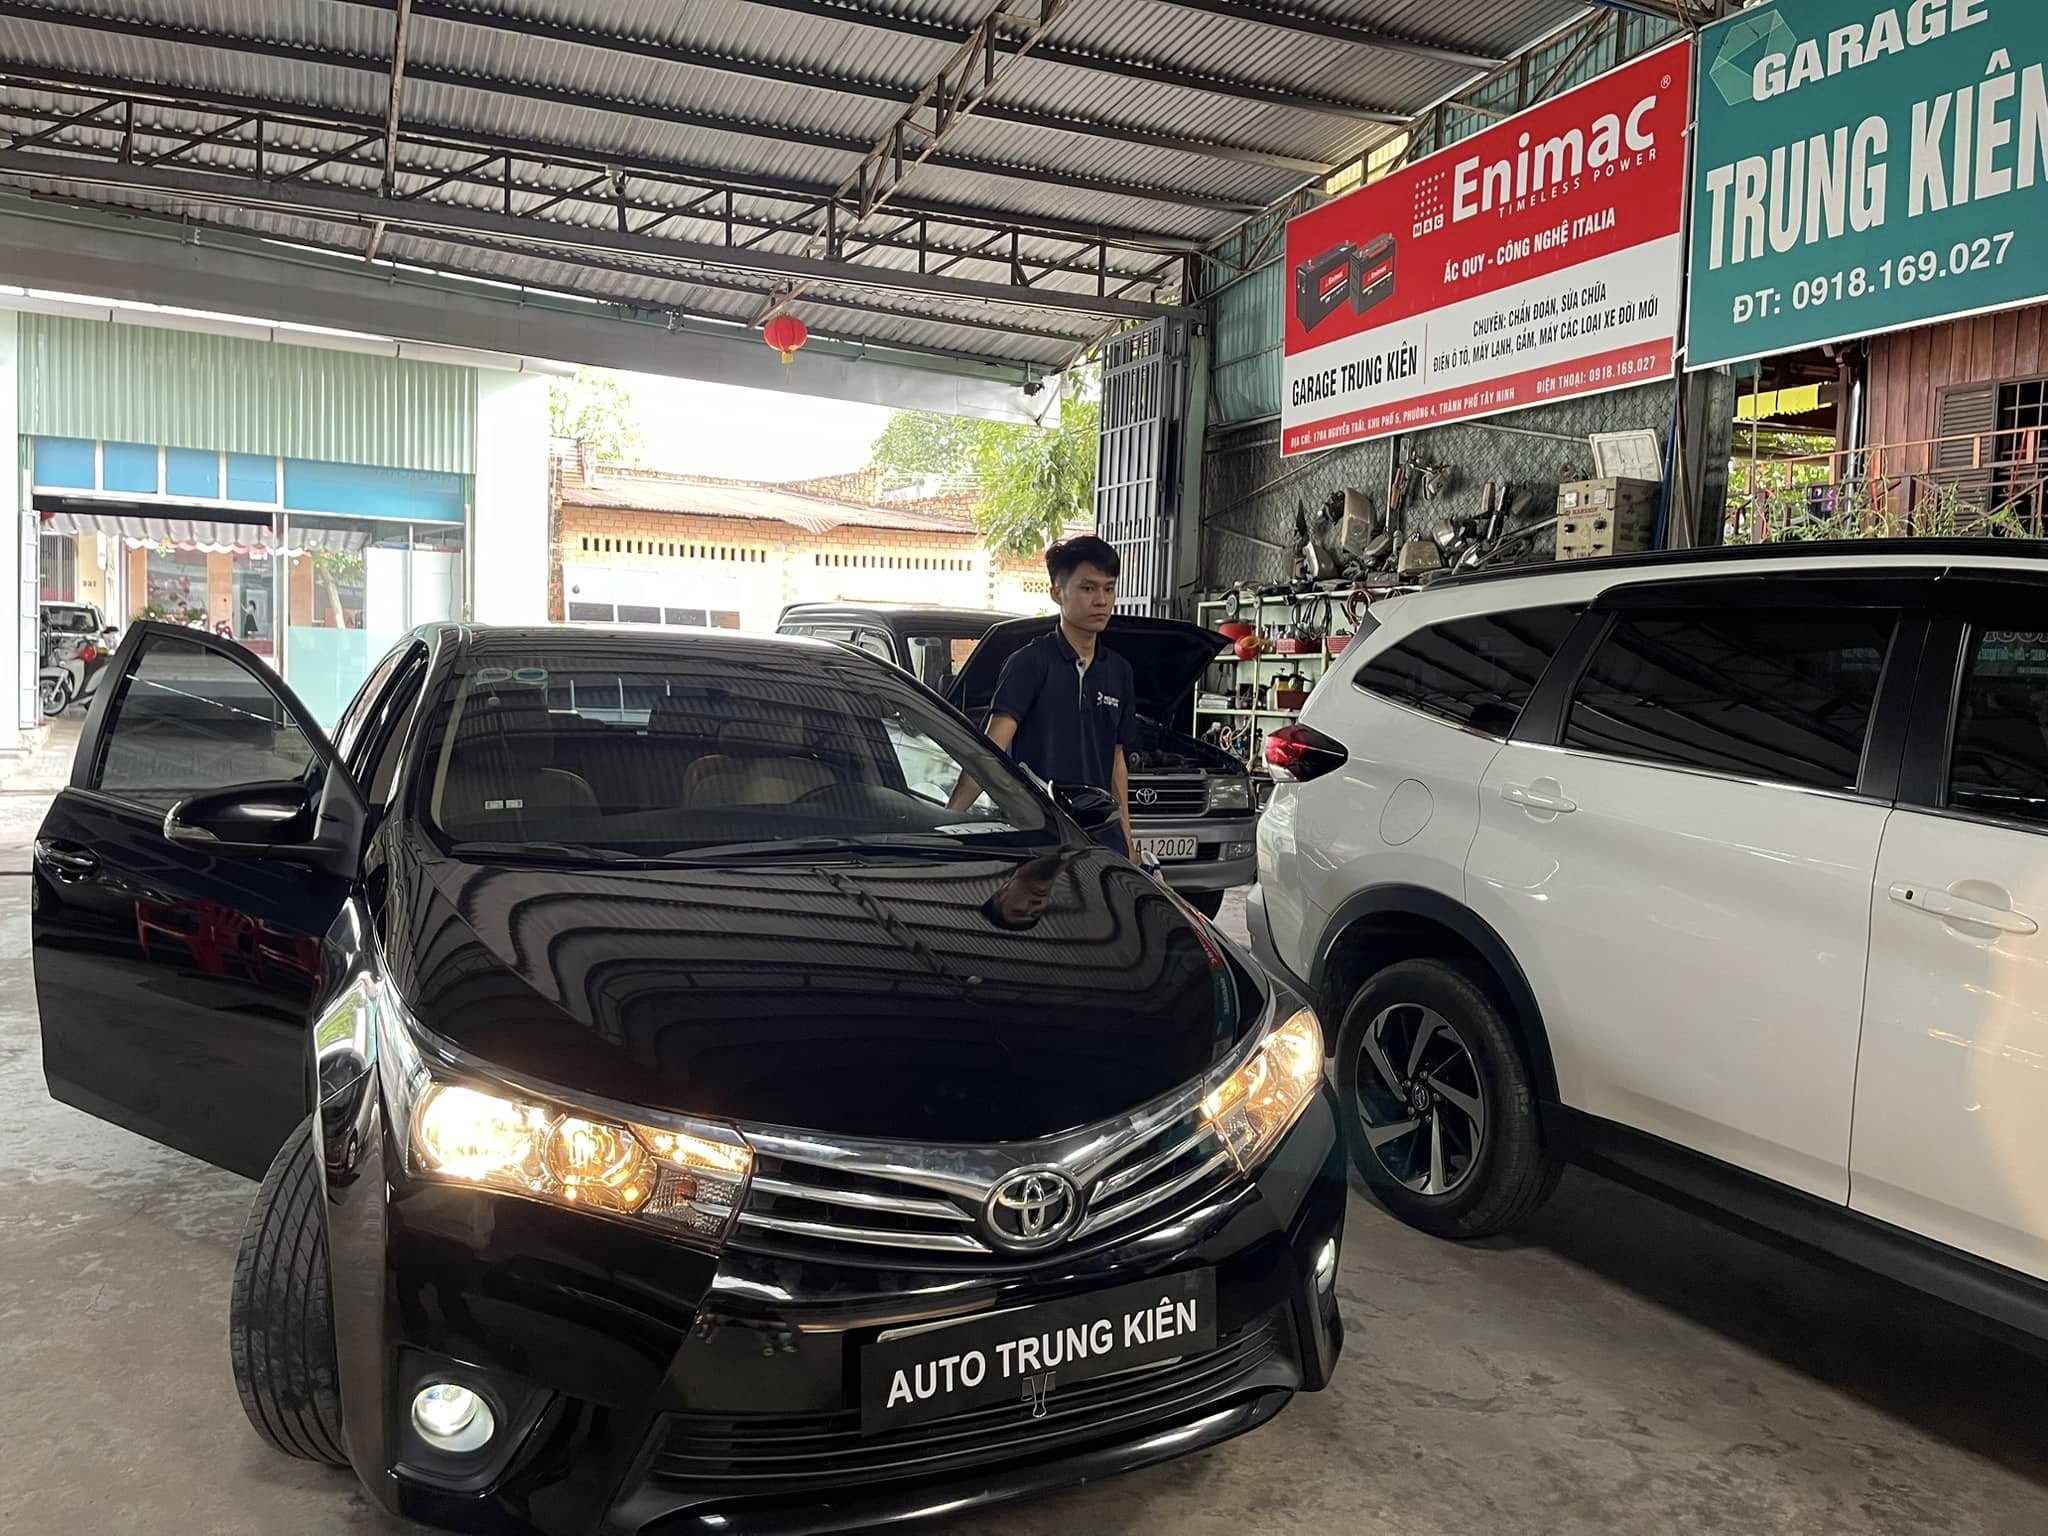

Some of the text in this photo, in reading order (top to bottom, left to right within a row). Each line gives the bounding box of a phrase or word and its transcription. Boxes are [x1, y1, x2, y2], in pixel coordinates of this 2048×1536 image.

[1752, 0, 1989, 101] GARAGE
[1452, 95, 1657, 223] Enimac
[1498, 148, 1657, 218] TIMELESS POWER
[1706, 47, 2048, 271] TRUNG KIÊN
[1412, 213, 1444, 238] MAC
[1462, 253, 1485, 279] QUY
[1497, 238, 1530, 266] CÔNG
[1533, 219, 1569, 249] NGHỆ
[1572, 207, 1616, 240] ITALIA
[1732, 231, 2015, 323] ĐT: 0918.169.027
[1560, 317, 1578, 340] CÁC
[1581, 312, 1601, 336] LOẠI
[1603, 309, 1616, 329] XE
[1292, 340, 1418, 407] GARAGE TRUNG KIÊN
[1496, 386, 1515, 402] NINH
[1589, 355, 1656, 382] 0918.169.027
[886, 1296, 1197, 1409] AUTO TRUNG KIÊN
